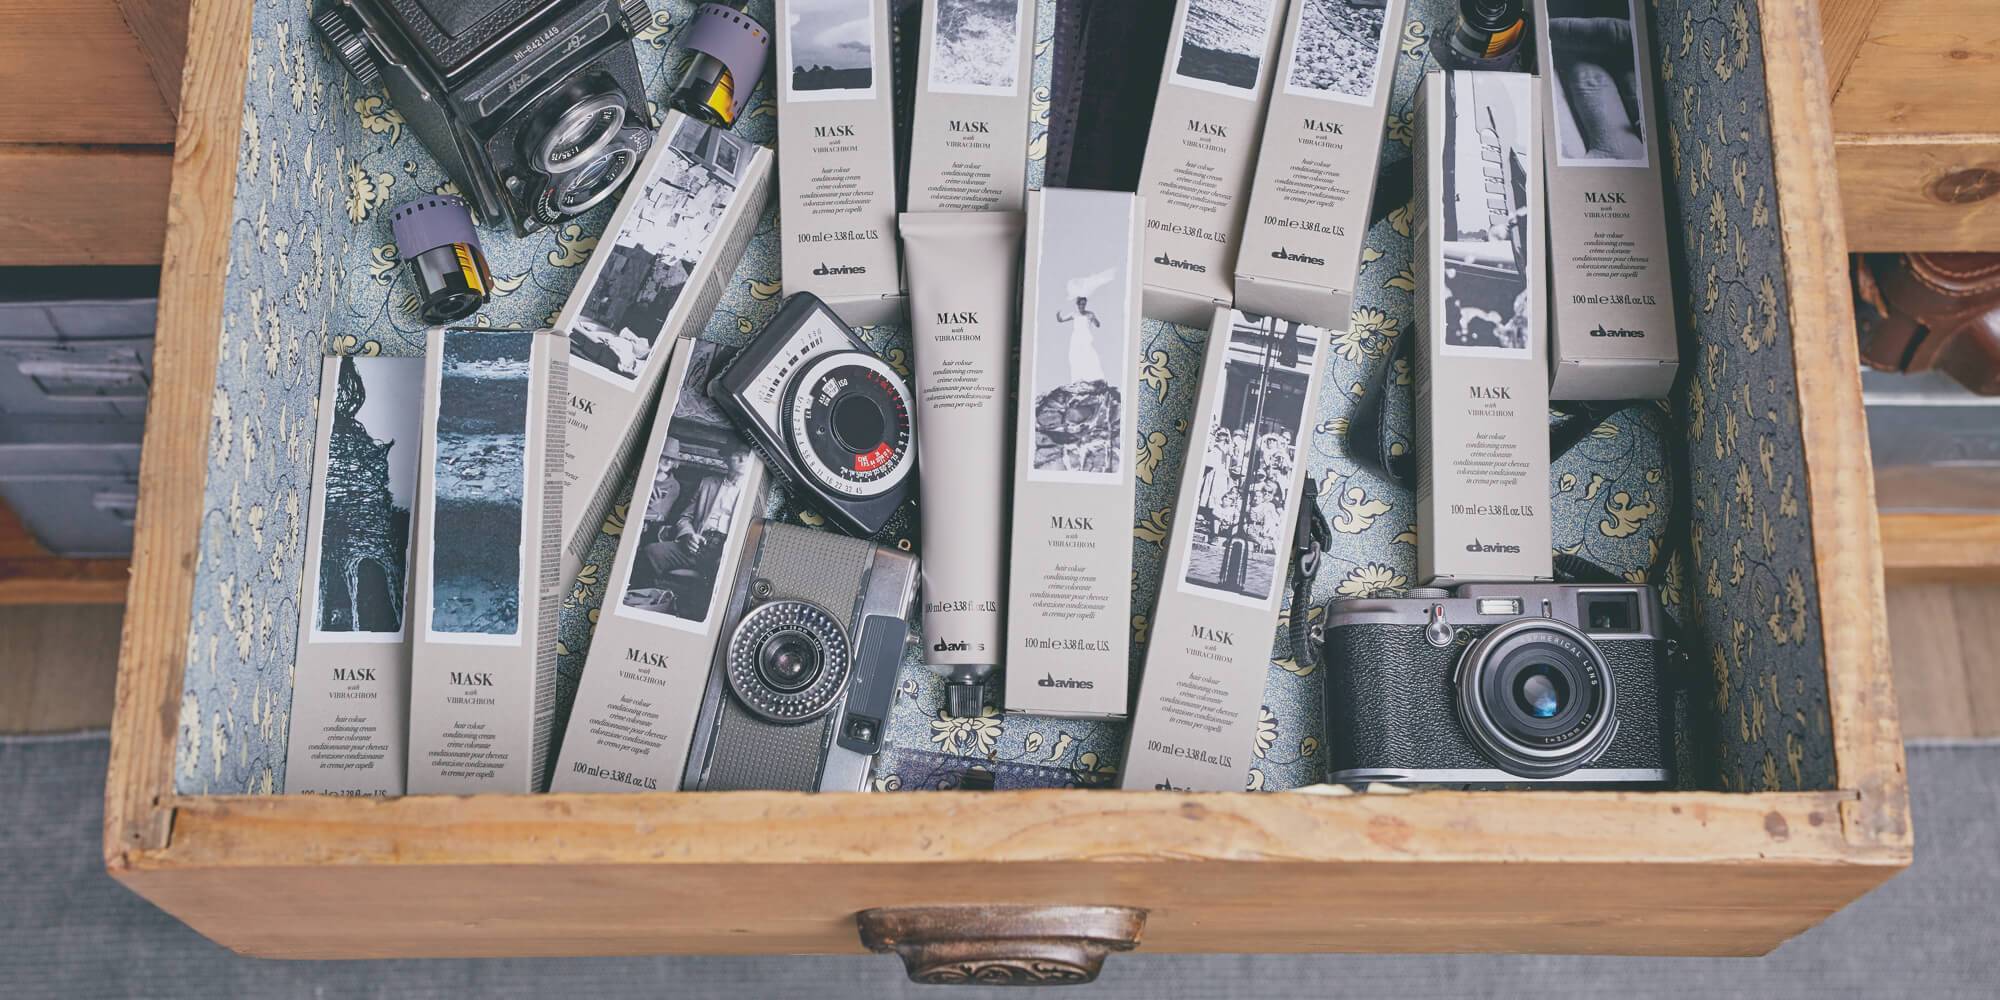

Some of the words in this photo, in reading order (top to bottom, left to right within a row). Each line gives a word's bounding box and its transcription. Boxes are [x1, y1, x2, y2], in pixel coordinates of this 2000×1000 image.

[815, 125, 854, 137] MASK
[950, 120, 989, 133] MASK
[1188, 120, 1227, 137] MASK
[1303, 119, 1343, 134] MASK
[1183, 139, 1226, 153] VIBRACHROM
[1298, 138, 1343, 150] VIBRACHROM
[1585, 192, 1626, 203] MASK
[1147, 219, 1160, 229] 100
[1161, 222, 1172, 232] ml
[1182, 226, 1196, 236] 3.38
[1264, 216, 1277, 225] 100
[1278, 218, 1289, 227] ml
[1299, 221, 1314, 231] 3.38
[798, 233, 810, 243] 100
[812, 232, 822, 242] ml
[834, 232, 847, 241] 3.38
[1154, 252, 1206, 273] davines
[1271, 246, 1324, 266] davines
[813, 262, 866, 275] davines
[1573, 295, 1586, 304] 100
[1587, 294, 1598, 304] ml
[1610, 295, 1624, 304] 3.38
[937, 312, 978, 324] MASK
[1590, 324, 1645, 338] davines
[1470, 386, 1511, 399] MASK
[568, 393, 596, 414] ASK
[1451, 504, 1464, 514] 100
[1466, 504, 1476, 514] ml
[1488, 505, 1502, 515] 3.38
[1052, 516, 1093, 530] MASK
[1048, 540, 1095, 548] VIBRACHROM
[1466, 537, 1520, 553] davines
[953, 601, 967, 611] 3.38
[1192, 625, 1233, 645] MASK
[1025, 638, 1038, 648] 100
[1040, 638, 1050, 648] ml
[1063, 639, 1077, 650] 3.38
[626, 648, 668, 668] MASK
[1186, 647, 1233, 664] VIBRACHROM
[333, 668, 375, 681] MASK
[450, 672, 493, 686] MASK
[620, 670, 666, 686] VIBRACHROM
[1584, 660, 1597, 685] LENS
[1038, 672, 1094, 689] davines
[447, 697, 495, 705] VIBRACHROM
[1148, 740, 1162, 751] 100
[1162, 744, 1174, 754] ml
[1185, 748, 1200, 760] 3.38
[573, 762, 587, 773] 100
[587, 766, 600, 776] ml
[610, 770, 625, 782] 3.38
